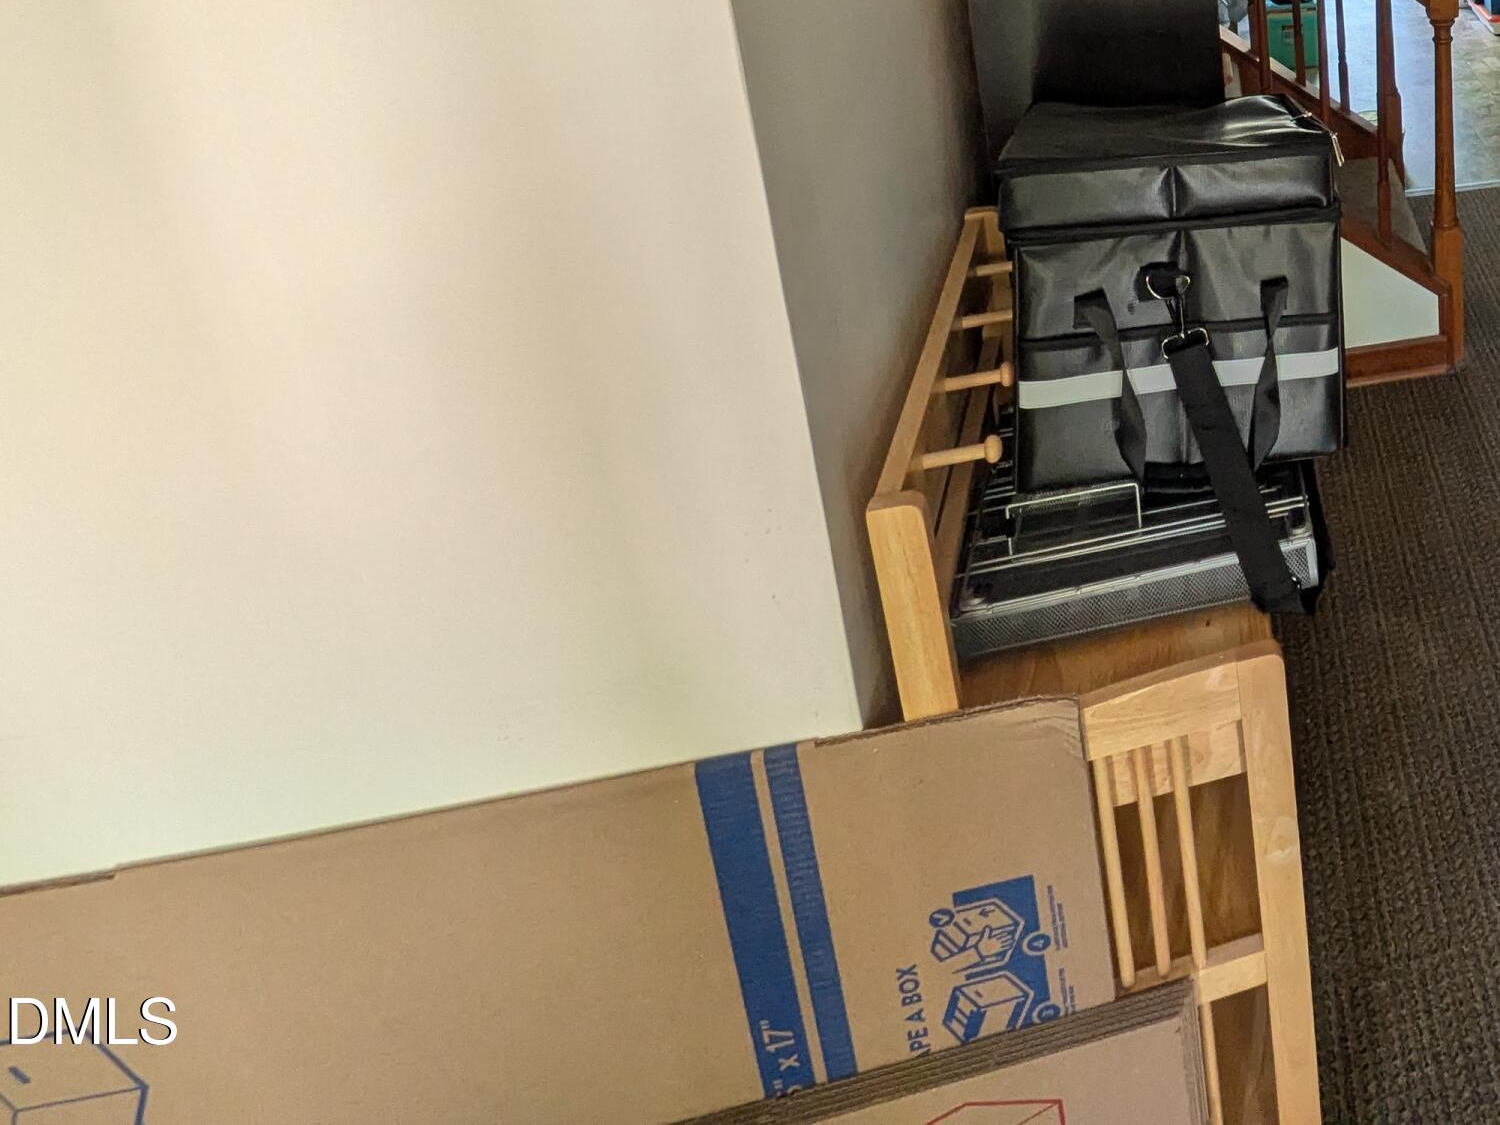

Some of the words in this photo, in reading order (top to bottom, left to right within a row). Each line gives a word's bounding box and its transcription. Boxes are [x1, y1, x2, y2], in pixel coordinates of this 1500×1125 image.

[895, 964, 922, 1007] BOX
[904, 1007, 926, 1023] A
[759, 1019, 795, 1052] 17"
